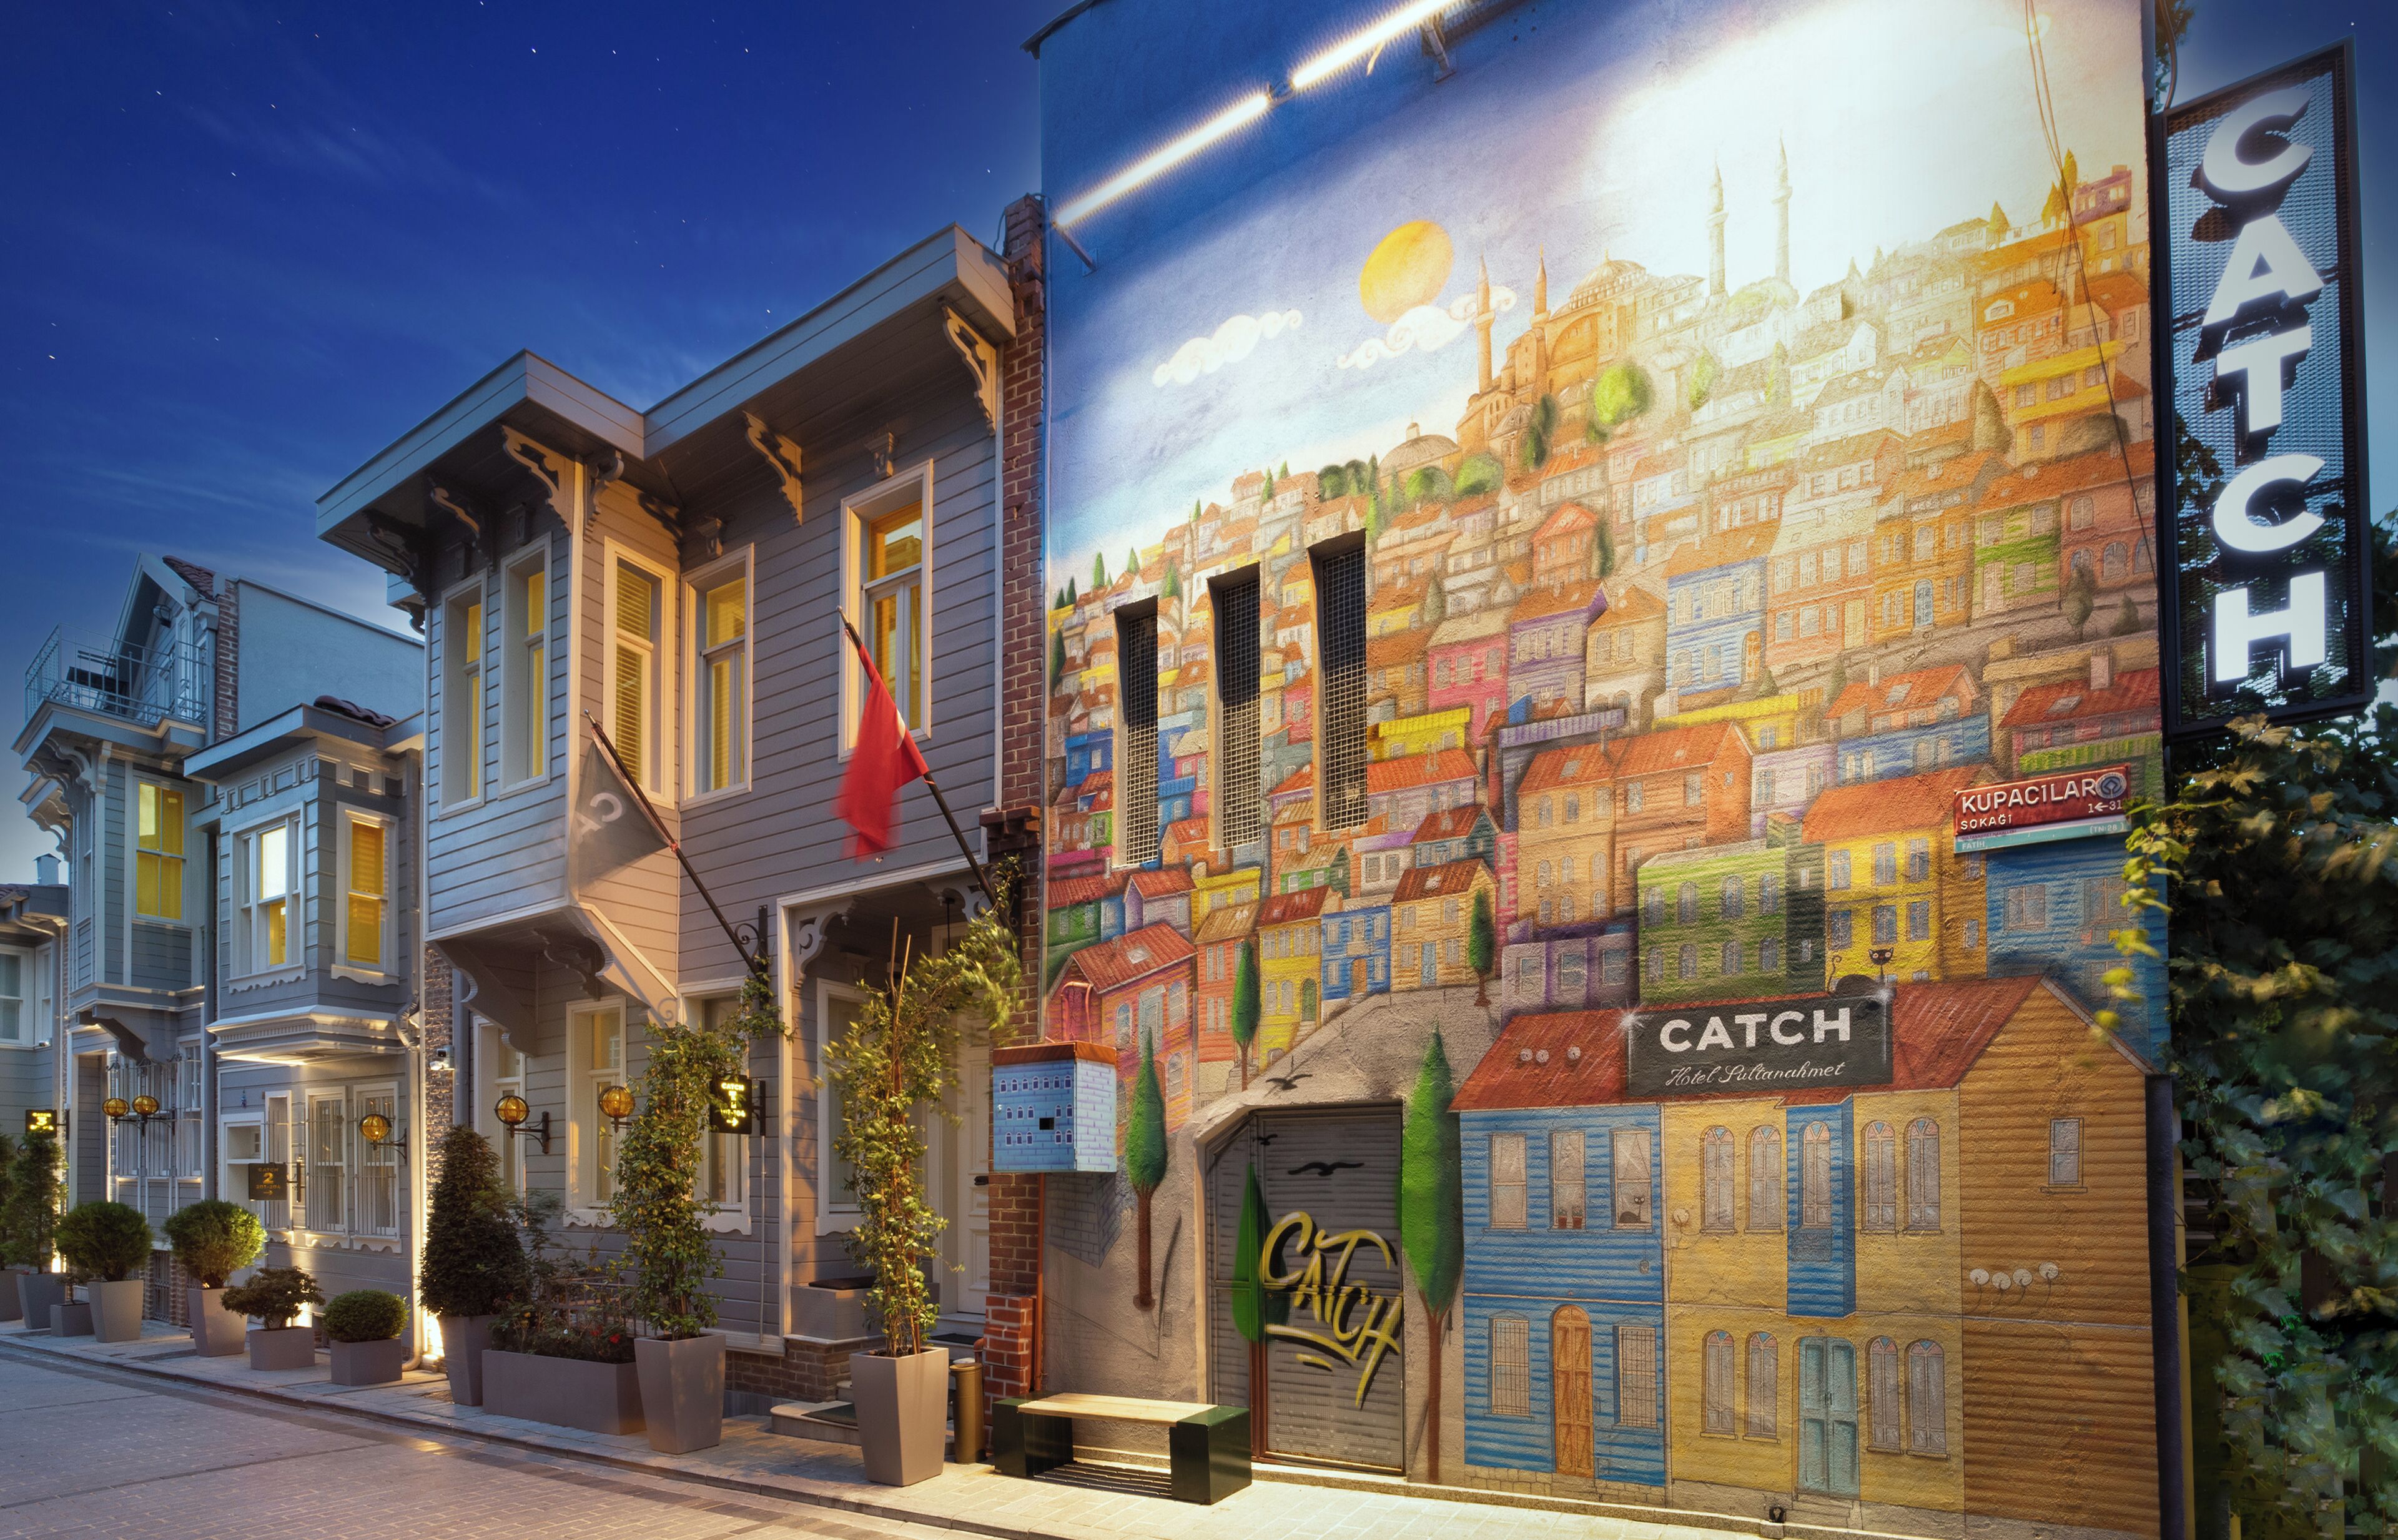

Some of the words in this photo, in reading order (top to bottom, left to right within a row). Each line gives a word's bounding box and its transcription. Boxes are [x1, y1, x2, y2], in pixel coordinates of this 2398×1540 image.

[2201, 87, 2326, 683] CATCH
[1961, 778, 2096, 814] KUPACILAR
[2109, 799, 2123, 811] 31
[1960, 814, 2012, 830] SOKAĞI
[1659, 1007, 1851, 1052] CATCH
[721, 1082, 744, 1092] CATCH
[1665, 1065, 1721, 1087] Hotel
[1719, 1060, 1846, 1083] Sultanahmet
[262, 1172, 274, 1184] 2
[1259, 1210, 1403, 1408] CATCH
